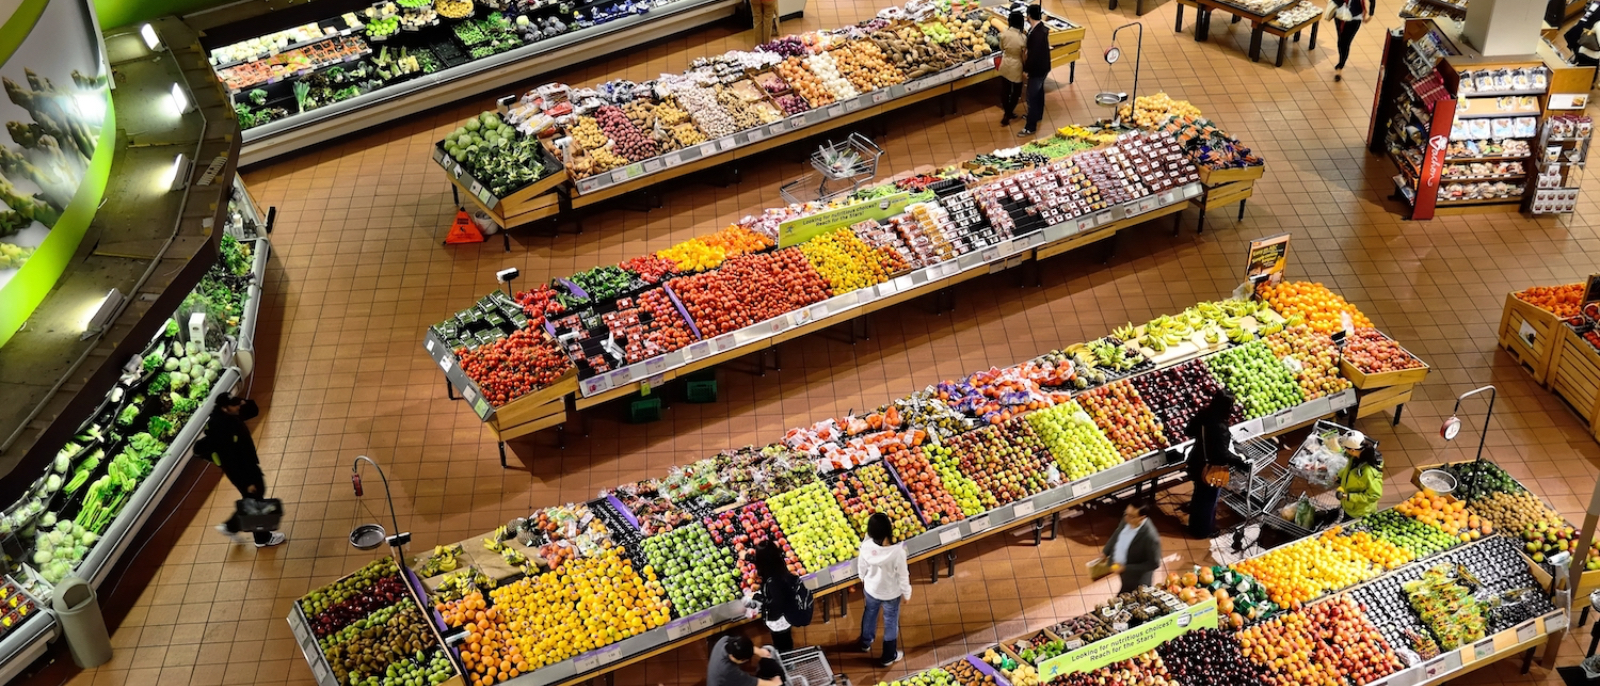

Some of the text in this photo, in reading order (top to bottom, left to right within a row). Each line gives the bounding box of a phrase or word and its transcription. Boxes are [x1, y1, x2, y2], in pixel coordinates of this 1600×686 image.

[802, 216, 822, 226] Looking
[831, 209, 856, 219] nutritious
[856, 202, 878, 213] choices?
[816, 219, 832, 227] Reach
[1071, 648, 1098, 662] Looking
[1100, 643, 1109, 651] for
[1110, 632, 1144, 646] nutritious
[1145, 619, 1173, 634] choices?
[1090, 633, 1157, 662] Reach for the Stars!
